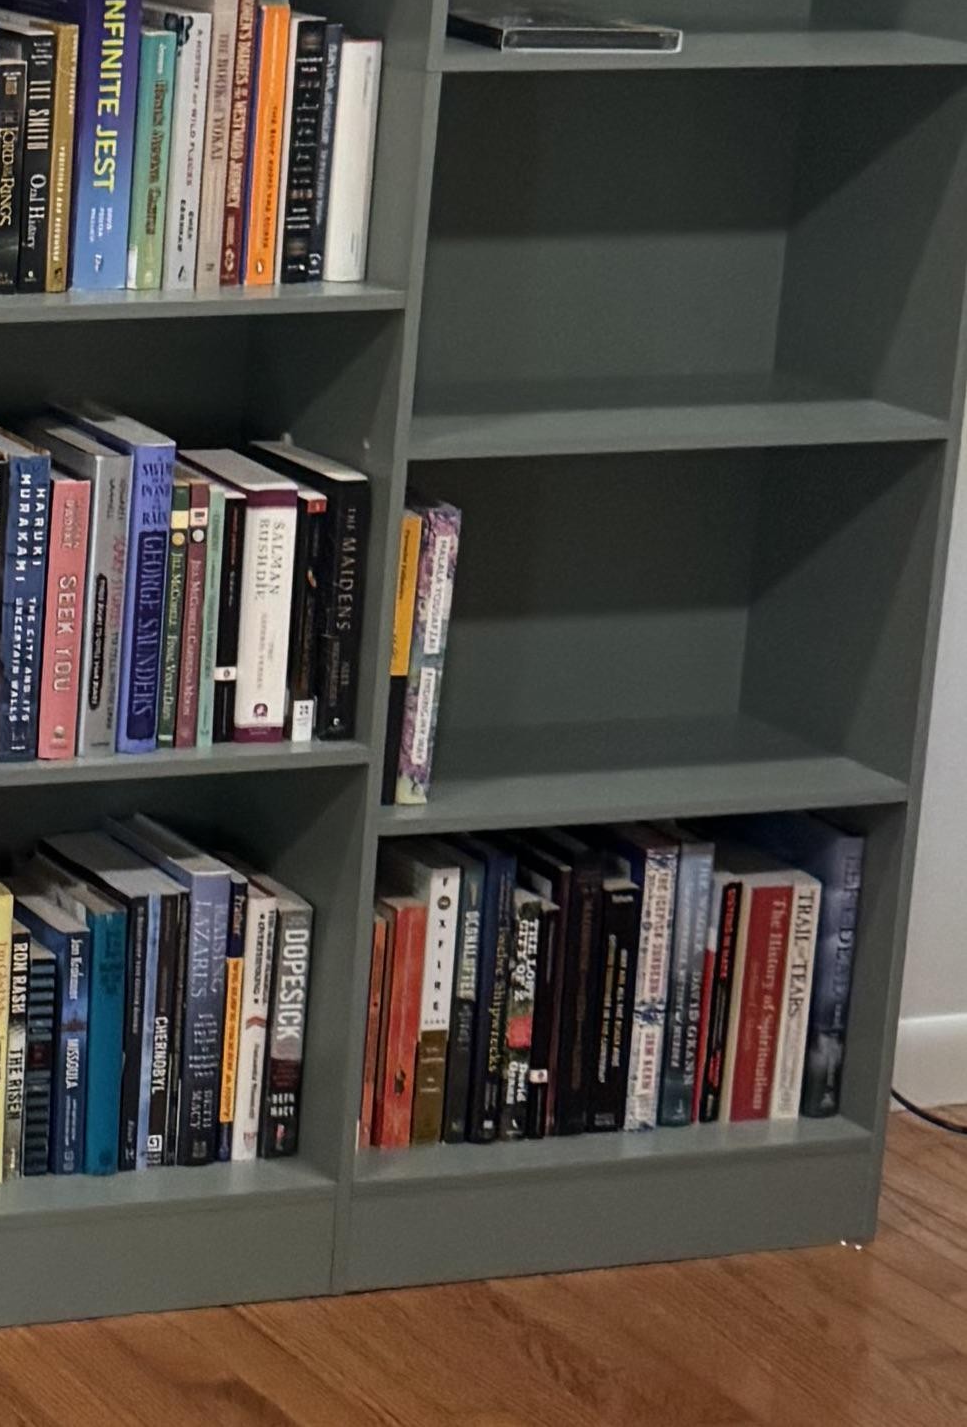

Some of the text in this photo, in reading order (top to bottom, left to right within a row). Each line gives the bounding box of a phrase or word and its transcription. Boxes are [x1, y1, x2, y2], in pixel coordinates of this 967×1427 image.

[94, 124, 117, 193] JEST
[16, 474, 31, 582] MURAKAMI
[33, 488, 46, 566] HARUKI
[254, 519, 270, 601] RUSHDIE
[270, 522, 285, 596] SALMAN
[134, 535, 164, 716] GEORGE SAUNDERS
[337, 537, 355, 631] MAIDENS
[53, 576, 77, 692] SEEK YOU
[795, 891, 814, 946] TRAIL
[277, 929, 309, 1040] DOPESICK
[488, 982, 503, 1072] Shipwrecks
[788, 961, 808, 1018] TEARS
[7, 943, 27, 1120] RON RASH THE RISEN
[152, 1017, 168, 1093] CHERNOBYL
